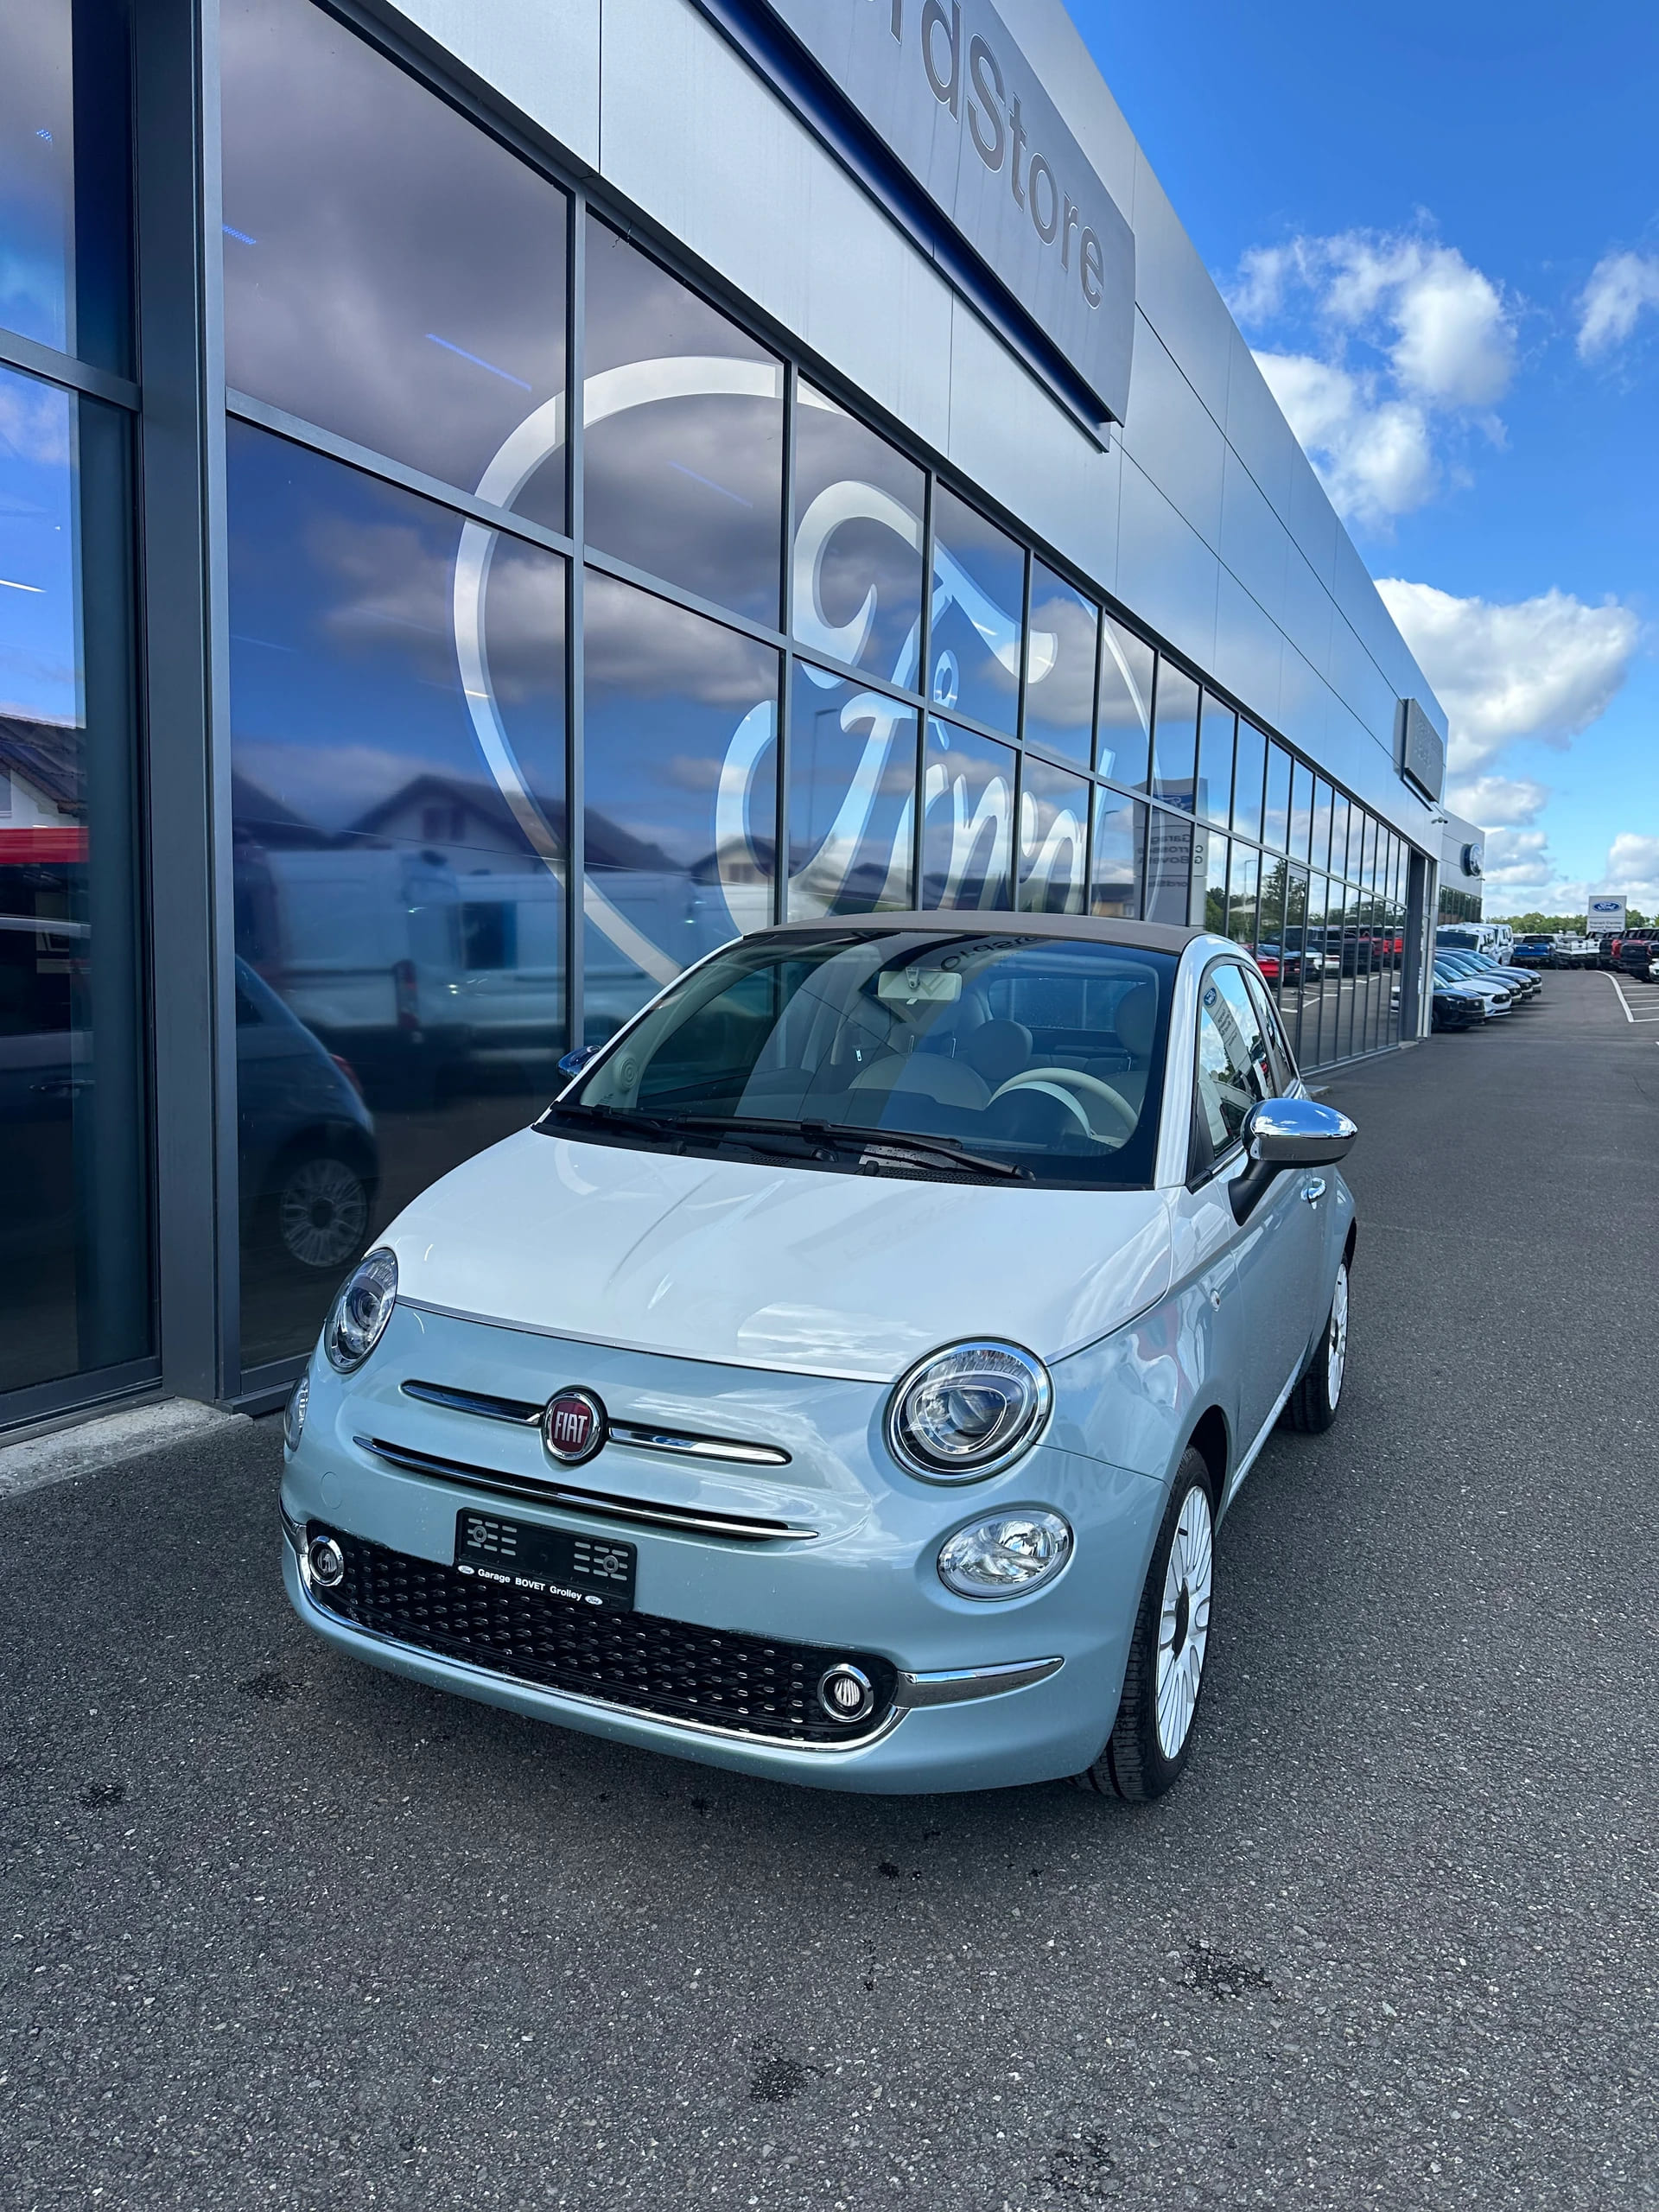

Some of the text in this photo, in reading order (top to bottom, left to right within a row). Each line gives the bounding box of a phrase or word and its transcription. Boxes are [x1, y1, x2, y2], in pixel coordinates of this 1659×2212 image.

[554, 1411, 588, 1444] FIAT
[478, 1568, 511, 1583] Garage
[515, 1577, 546, 1592] BOVET
[550, 1586, 582, 1601] Grolley
